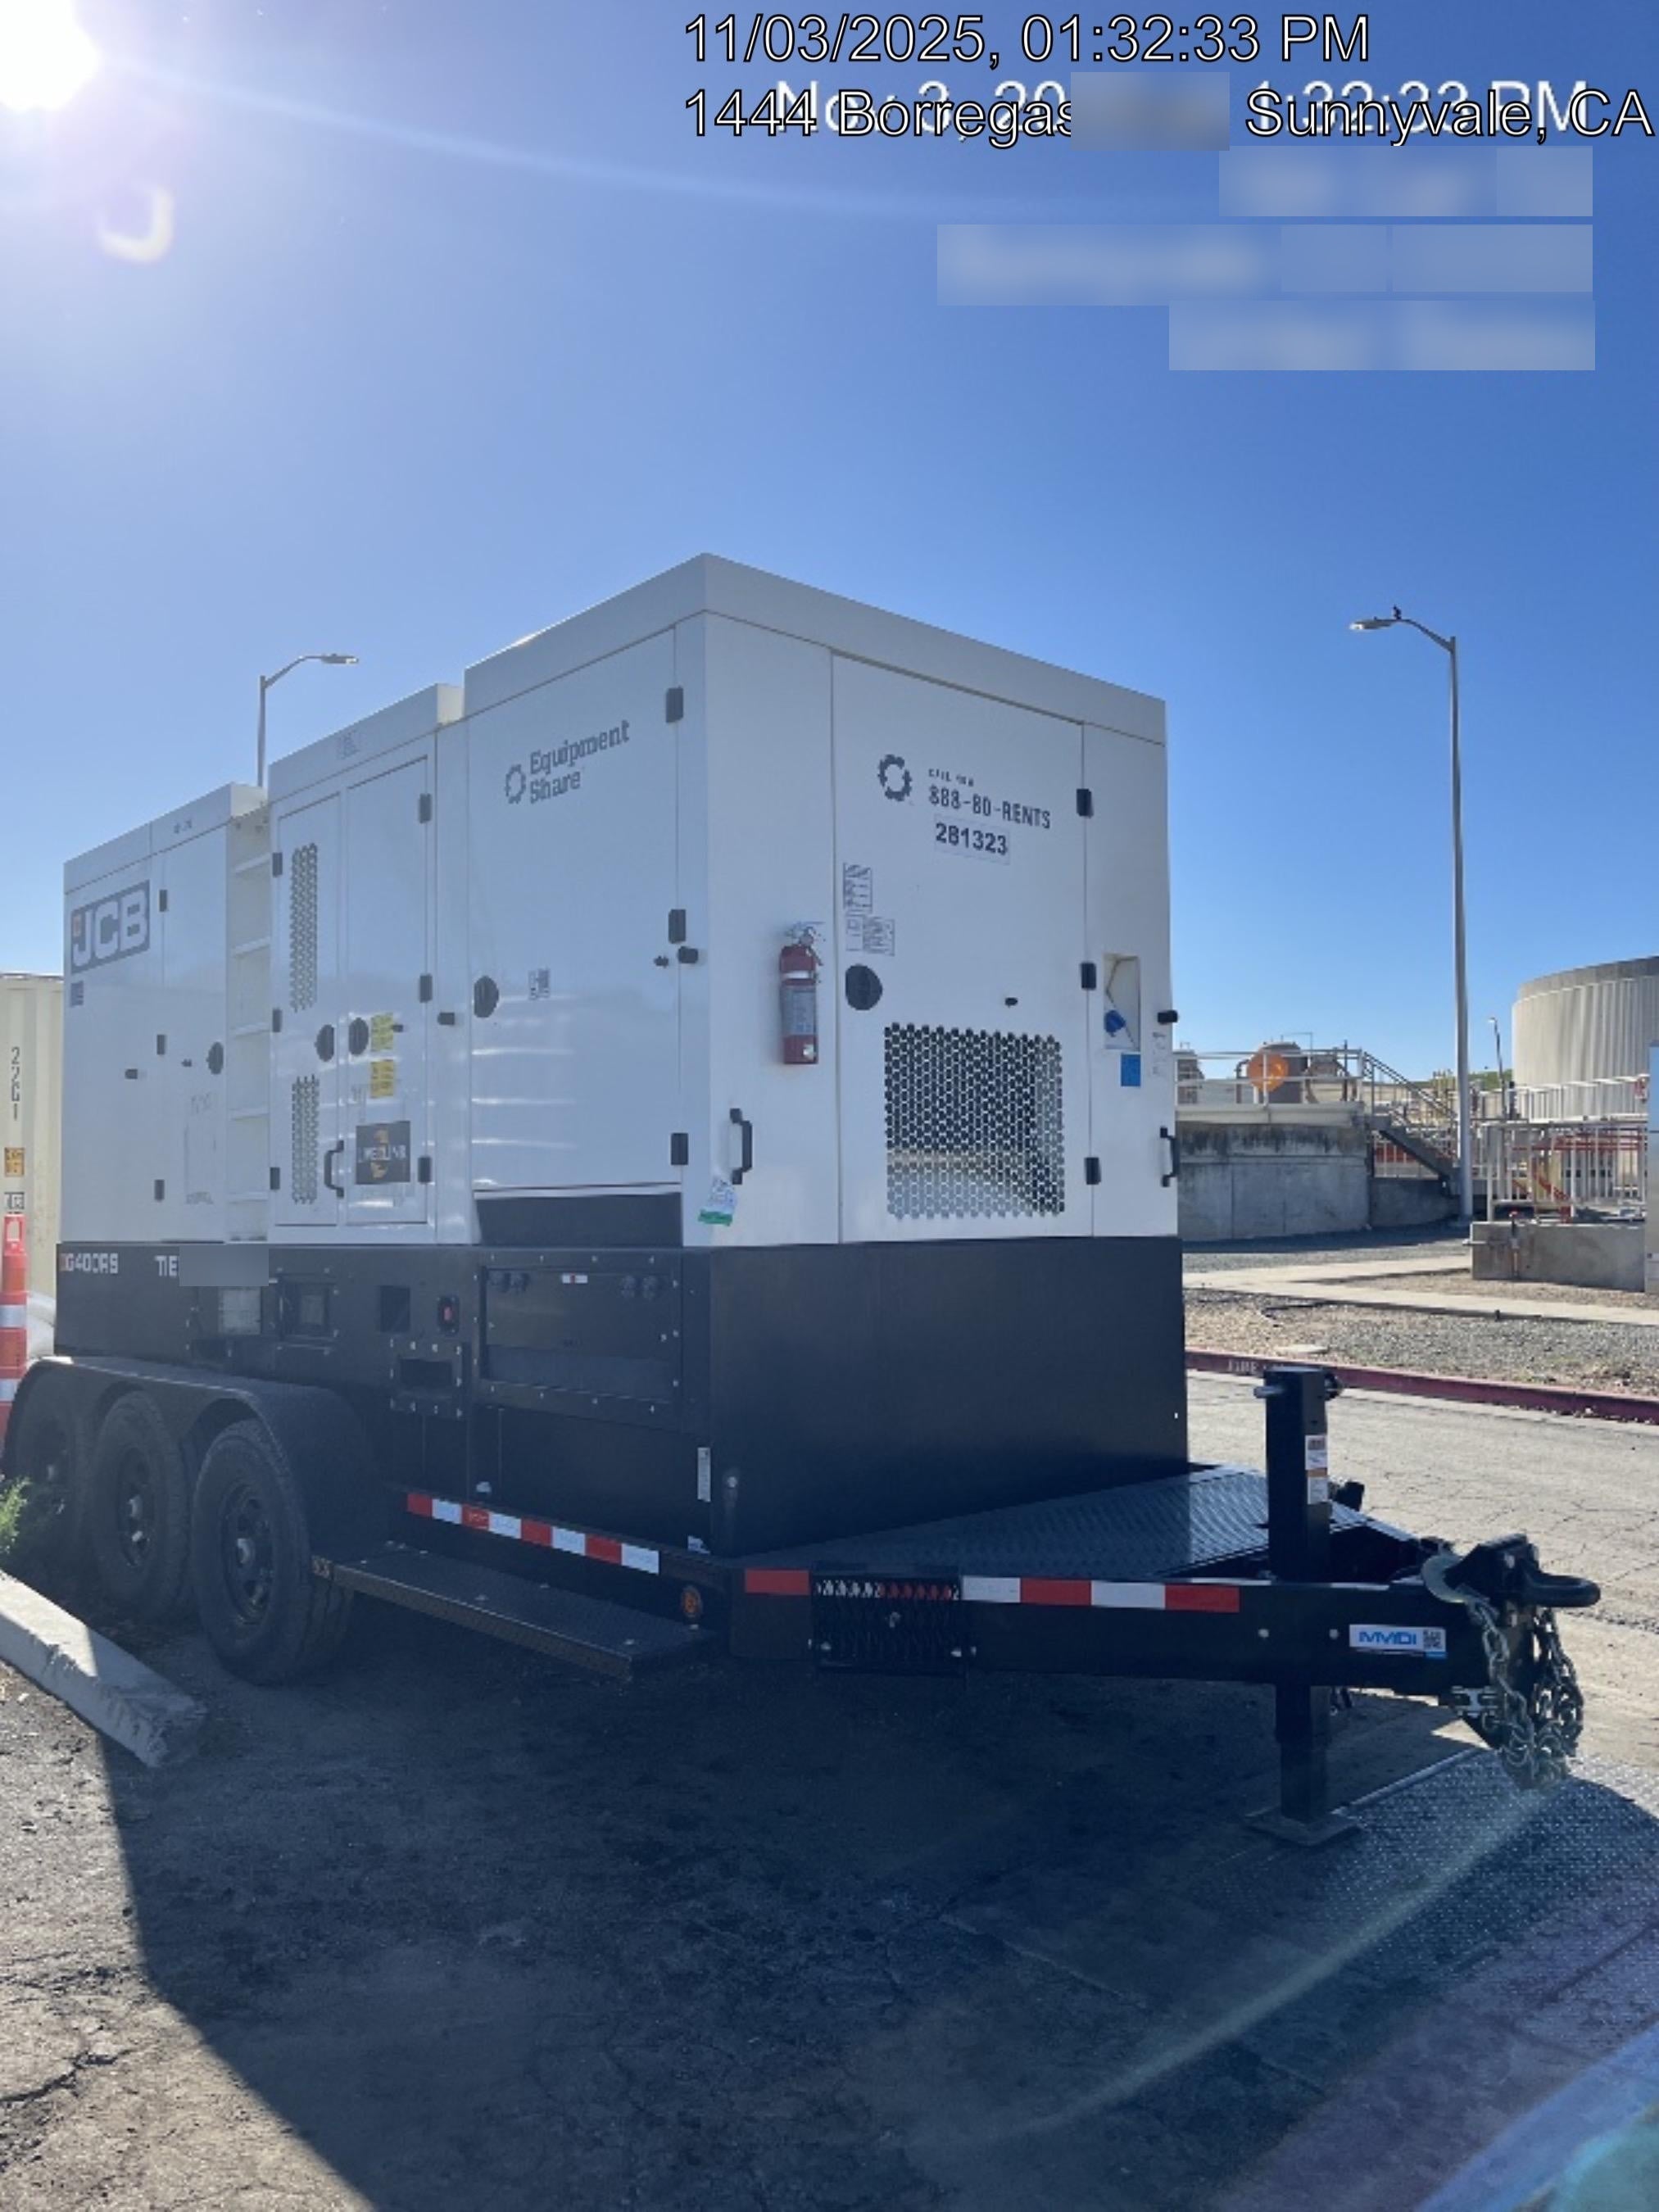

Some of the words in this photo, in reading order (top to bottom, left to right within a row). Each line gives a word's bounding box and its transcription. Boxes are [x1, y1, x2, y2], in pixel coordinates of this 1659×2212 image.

[529, 719, 630, 776] Equipment
[529, 771, 581, 805] Share
[71, 885, 149, 970] JCB
[154, 1254, 179, 1277] TIE
